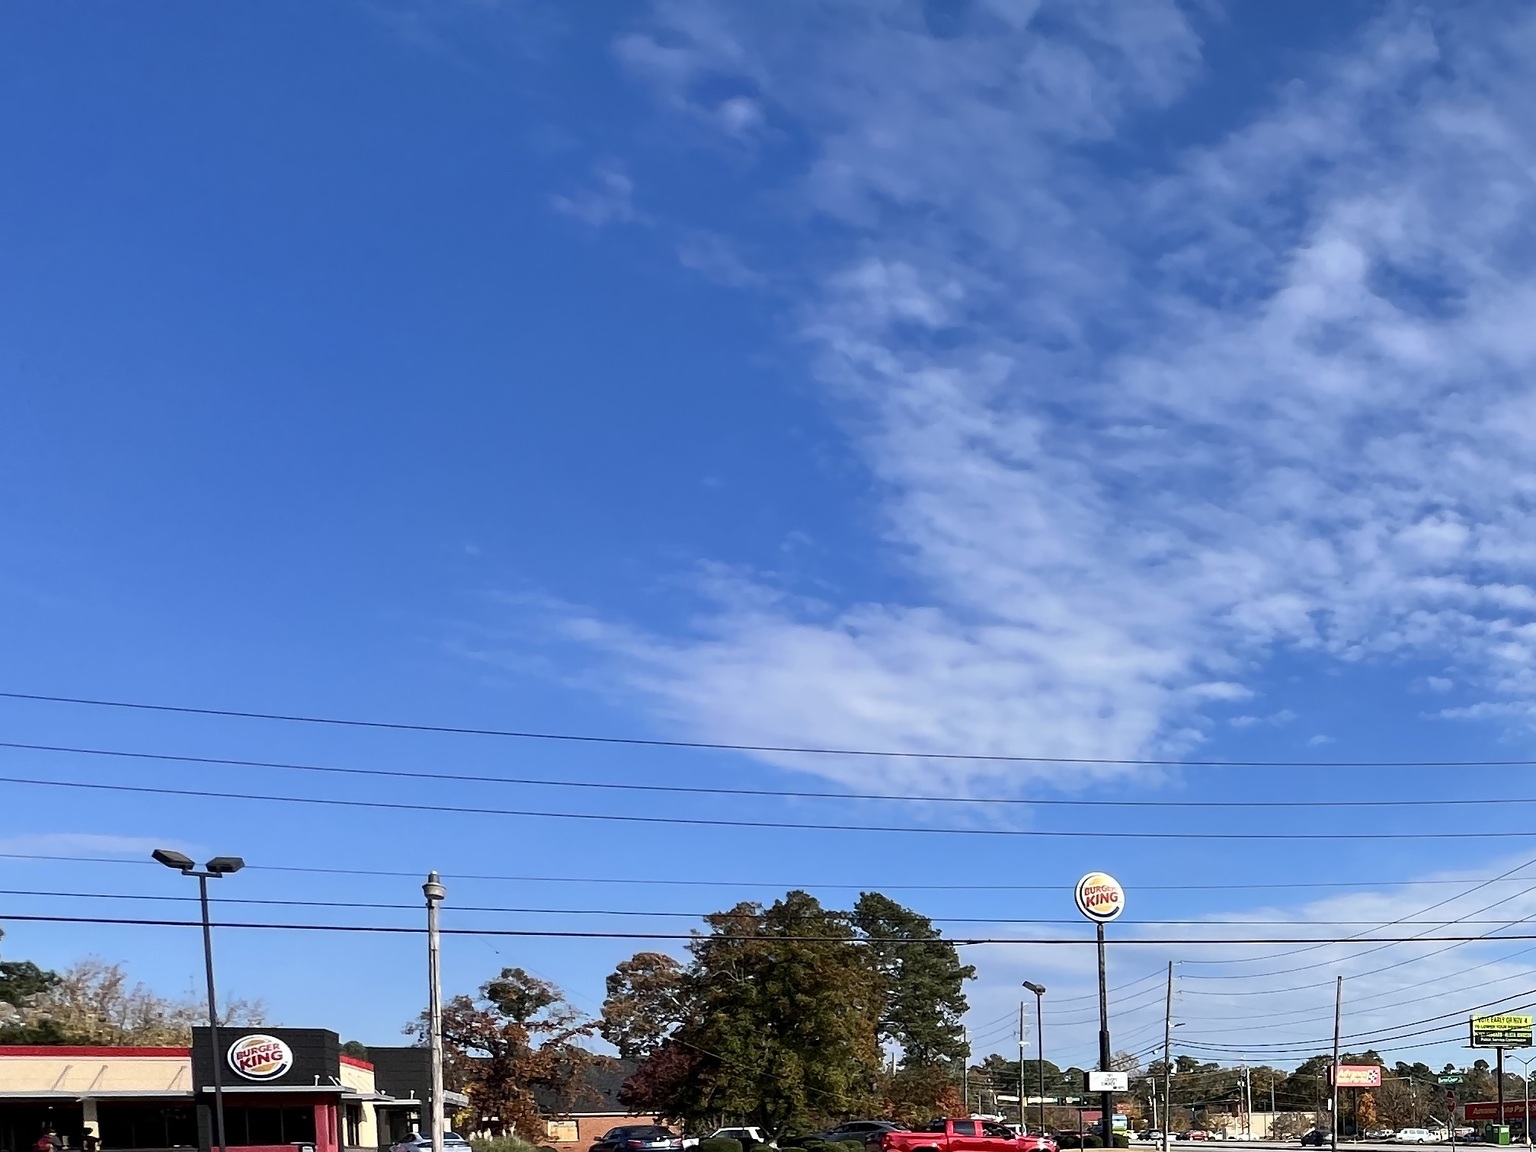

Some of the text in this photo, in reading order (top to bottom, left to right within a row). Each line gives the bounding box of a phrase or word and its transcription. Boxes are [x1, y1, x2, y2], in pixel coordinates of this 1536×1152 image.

[1084, 885, 1116, 896] BURGER
[1086, 892, 1118, 907] KING
[236, 1043, 280, 1060] BURGER
[240, 1051, 283, 1070] KING
